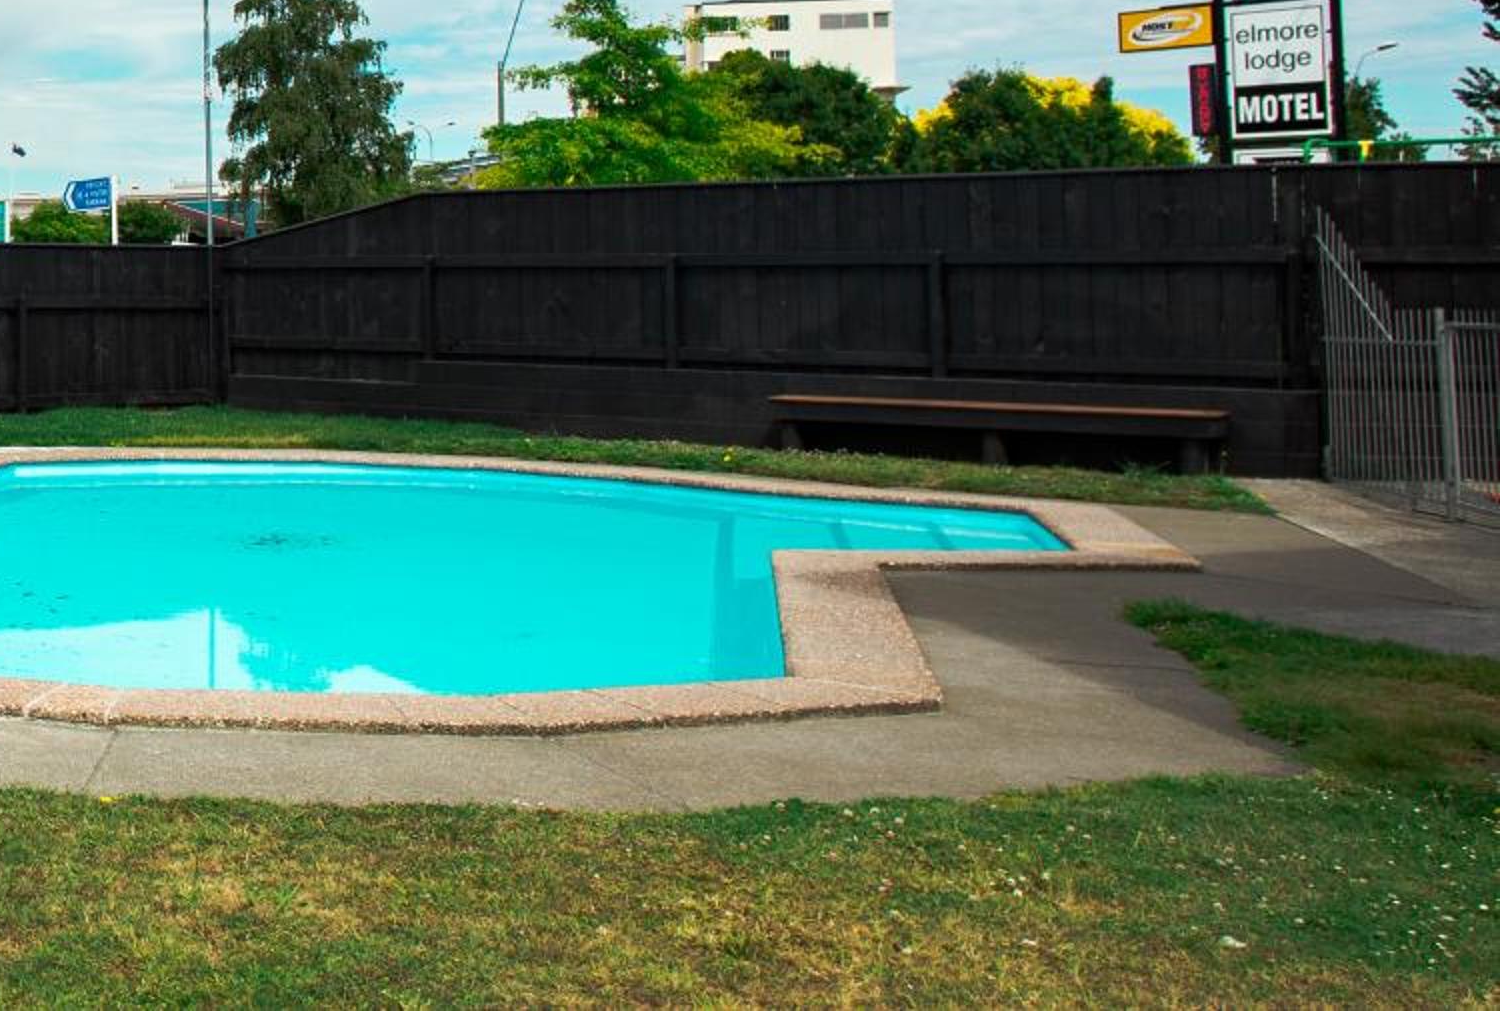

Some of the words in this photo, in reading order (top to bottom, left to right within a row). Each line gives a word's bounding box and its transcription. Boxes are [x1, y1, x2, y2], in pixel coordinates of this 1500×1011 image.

[1236, 23, 1319, 44] elmore
[1245, 49, 1312, 73] lodge
[1238, 92, 1325, 124] MOTEL
